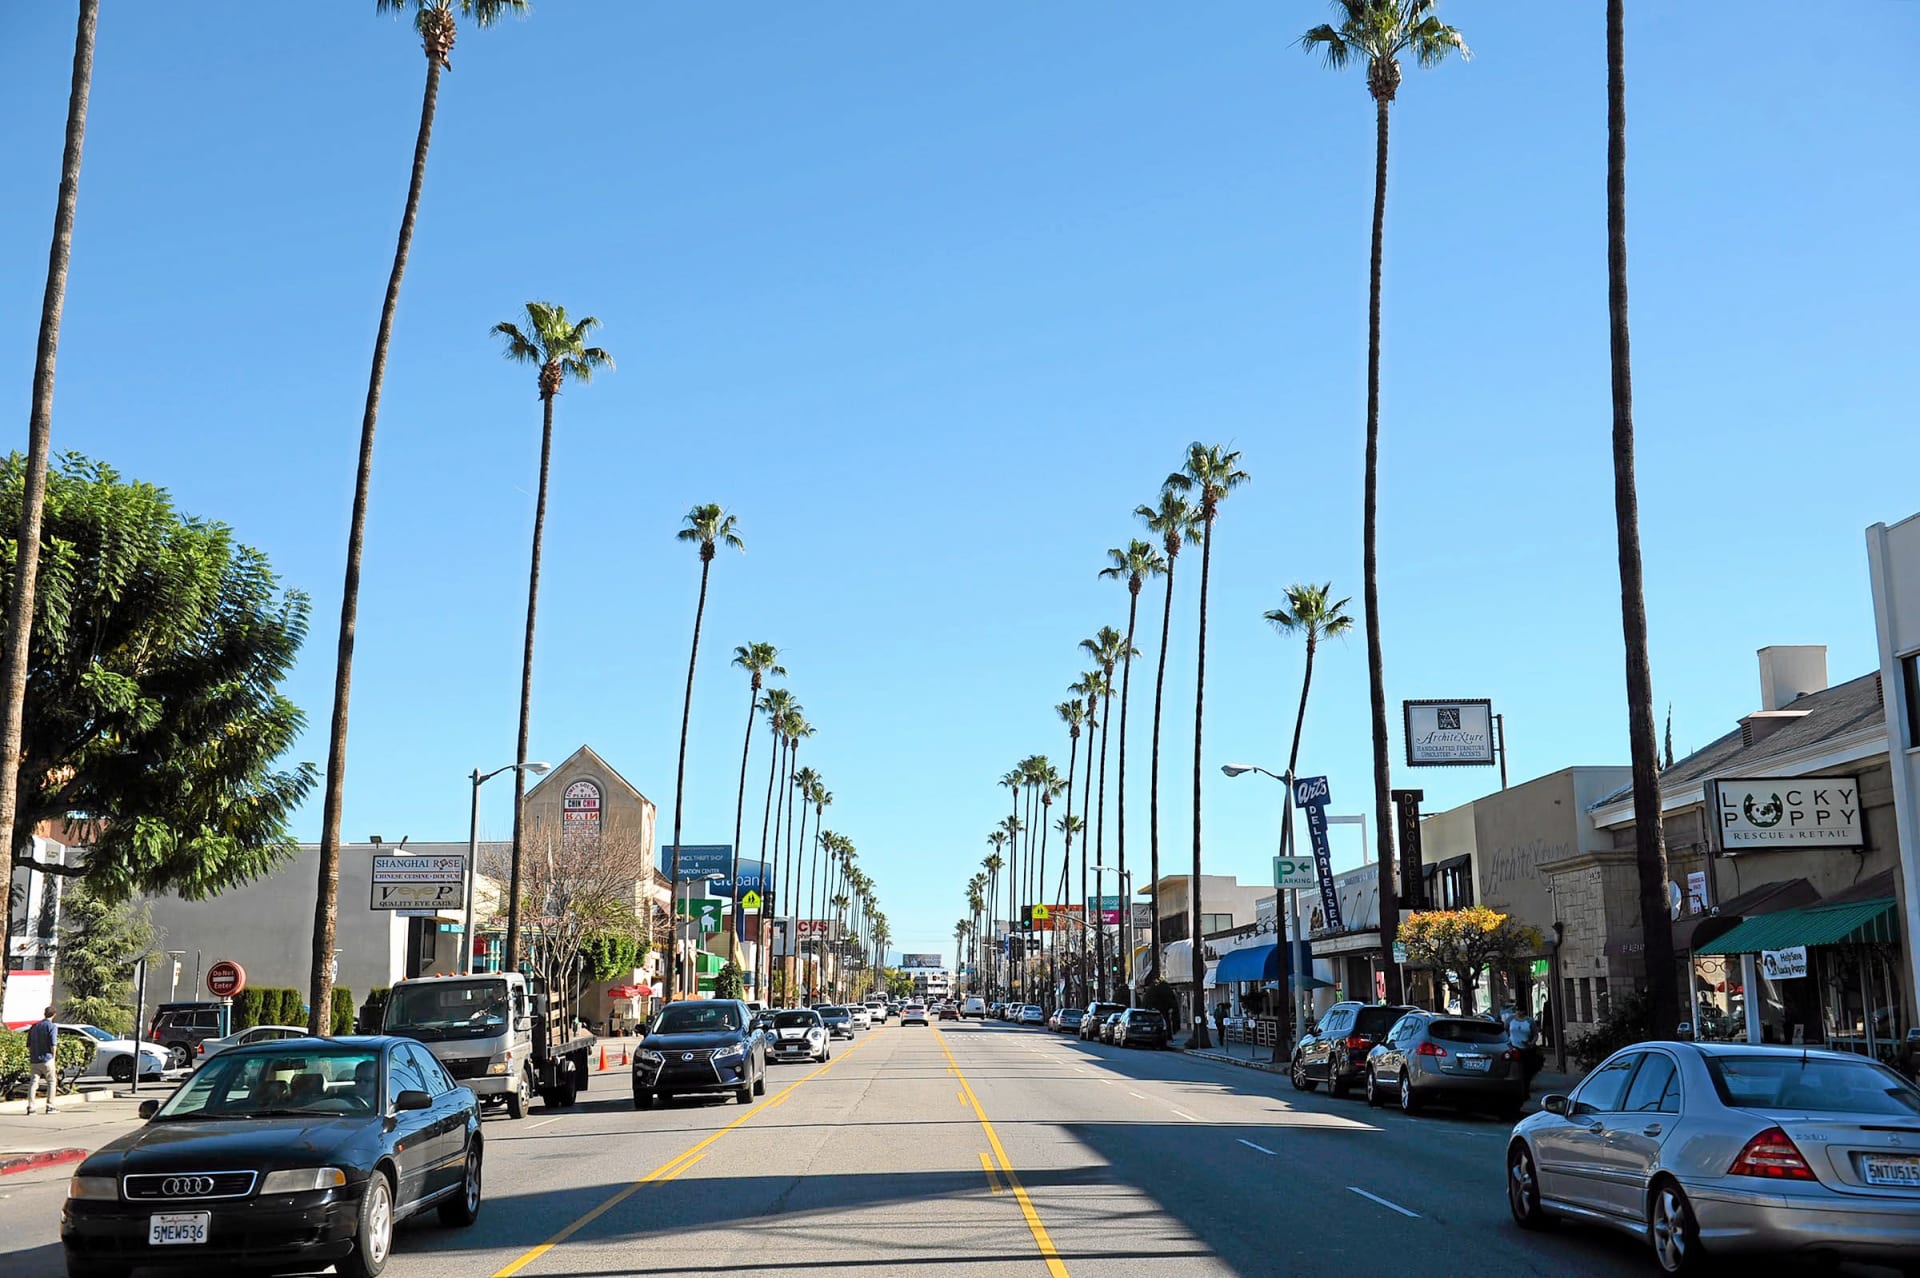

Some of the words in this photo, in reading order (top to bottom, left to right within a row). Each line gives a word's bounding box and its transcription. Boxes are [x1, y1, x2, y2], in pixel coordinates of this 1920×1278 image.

[568, 799, 581, 808] CHIN
[583, 799, 597, 808] CHIN
[1734, 831, 1785, 840] RESCUE
[1799, 830, 1848, 838] RETAIL
[376, 859, 429, 868] SHANGHAI
[798, 920, 828, 932] CVS
[214, 982, 233, 990] Enter
[1869, 1164, 1920, 1180] 5NTU515
[153, 1224, 204, 1241] 5MEW536
